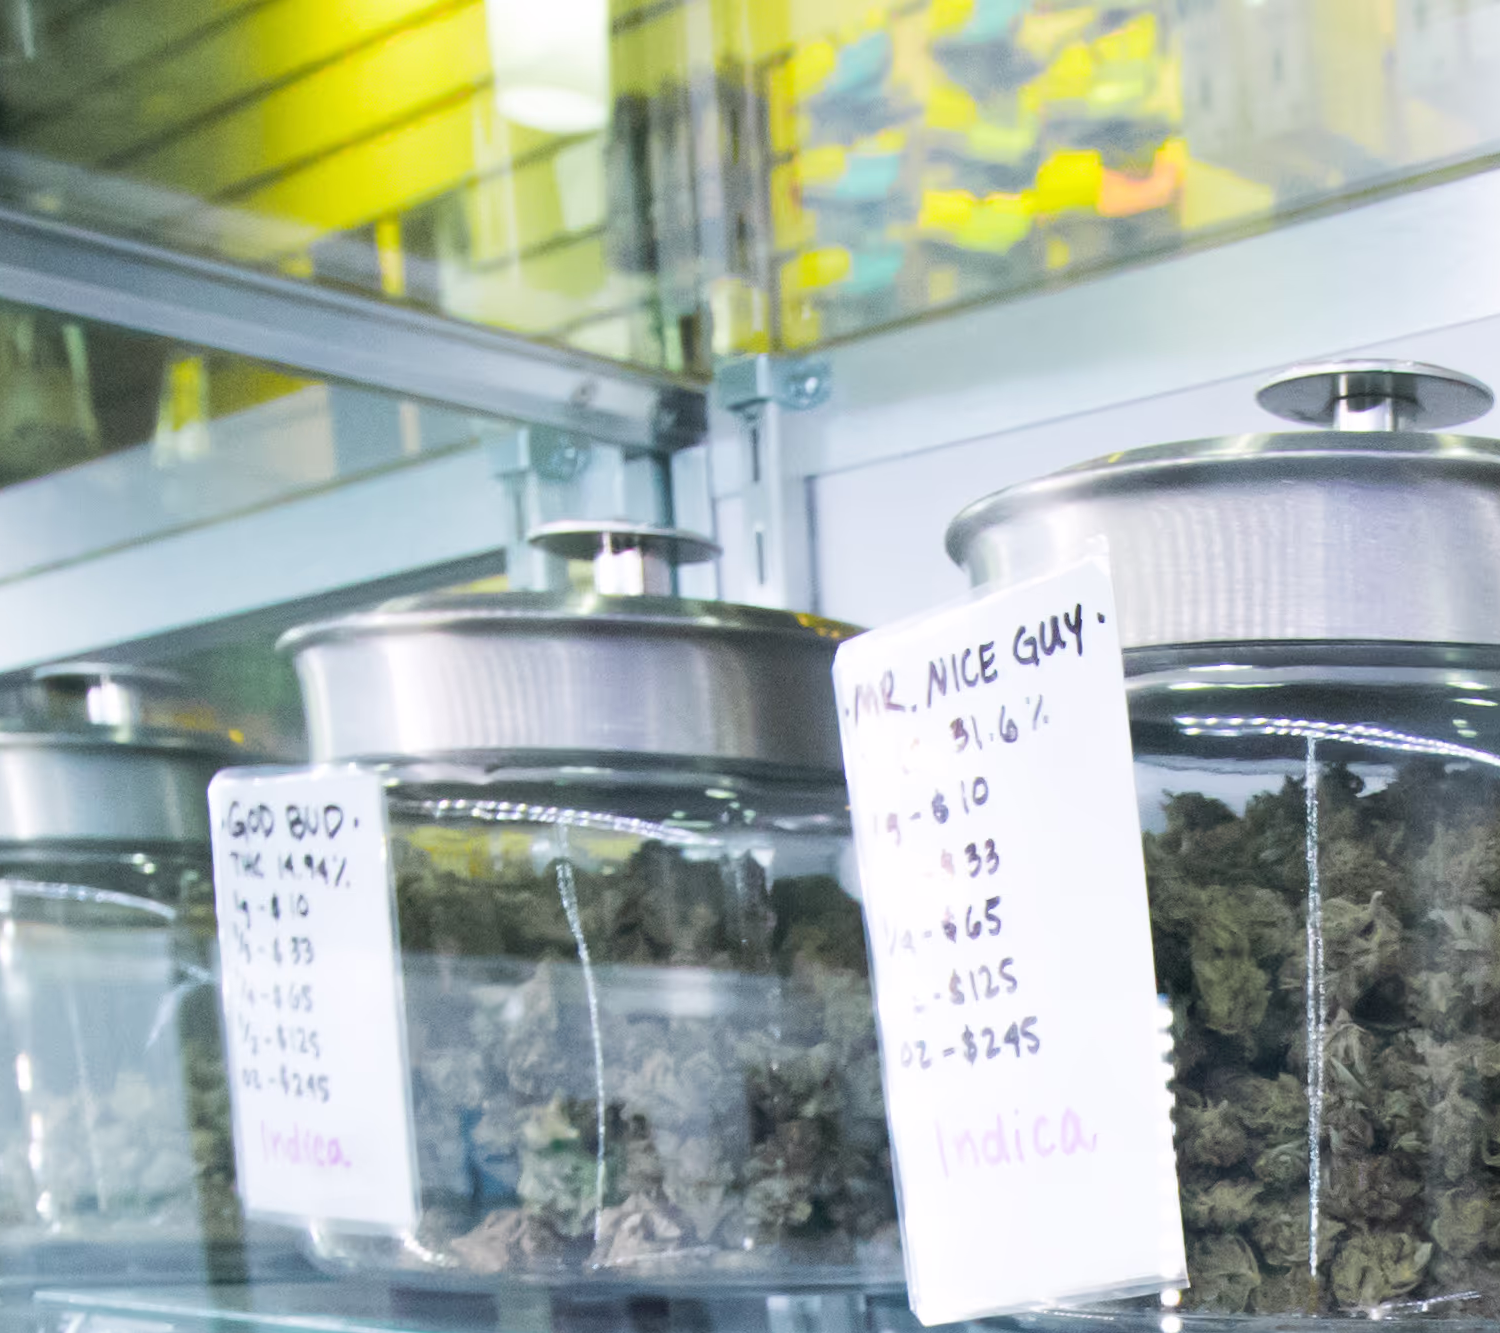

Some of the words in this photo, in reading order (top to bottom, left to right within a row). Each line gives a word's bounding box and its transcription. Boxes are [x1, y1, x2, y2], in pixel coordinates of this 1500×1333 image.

[926, 640, 999, 709] NICE
[1012, 602, 1084, 667] GUY
[285, 803, 346, 841] BUD
[933, 1106, 1099, 1179] Indica
